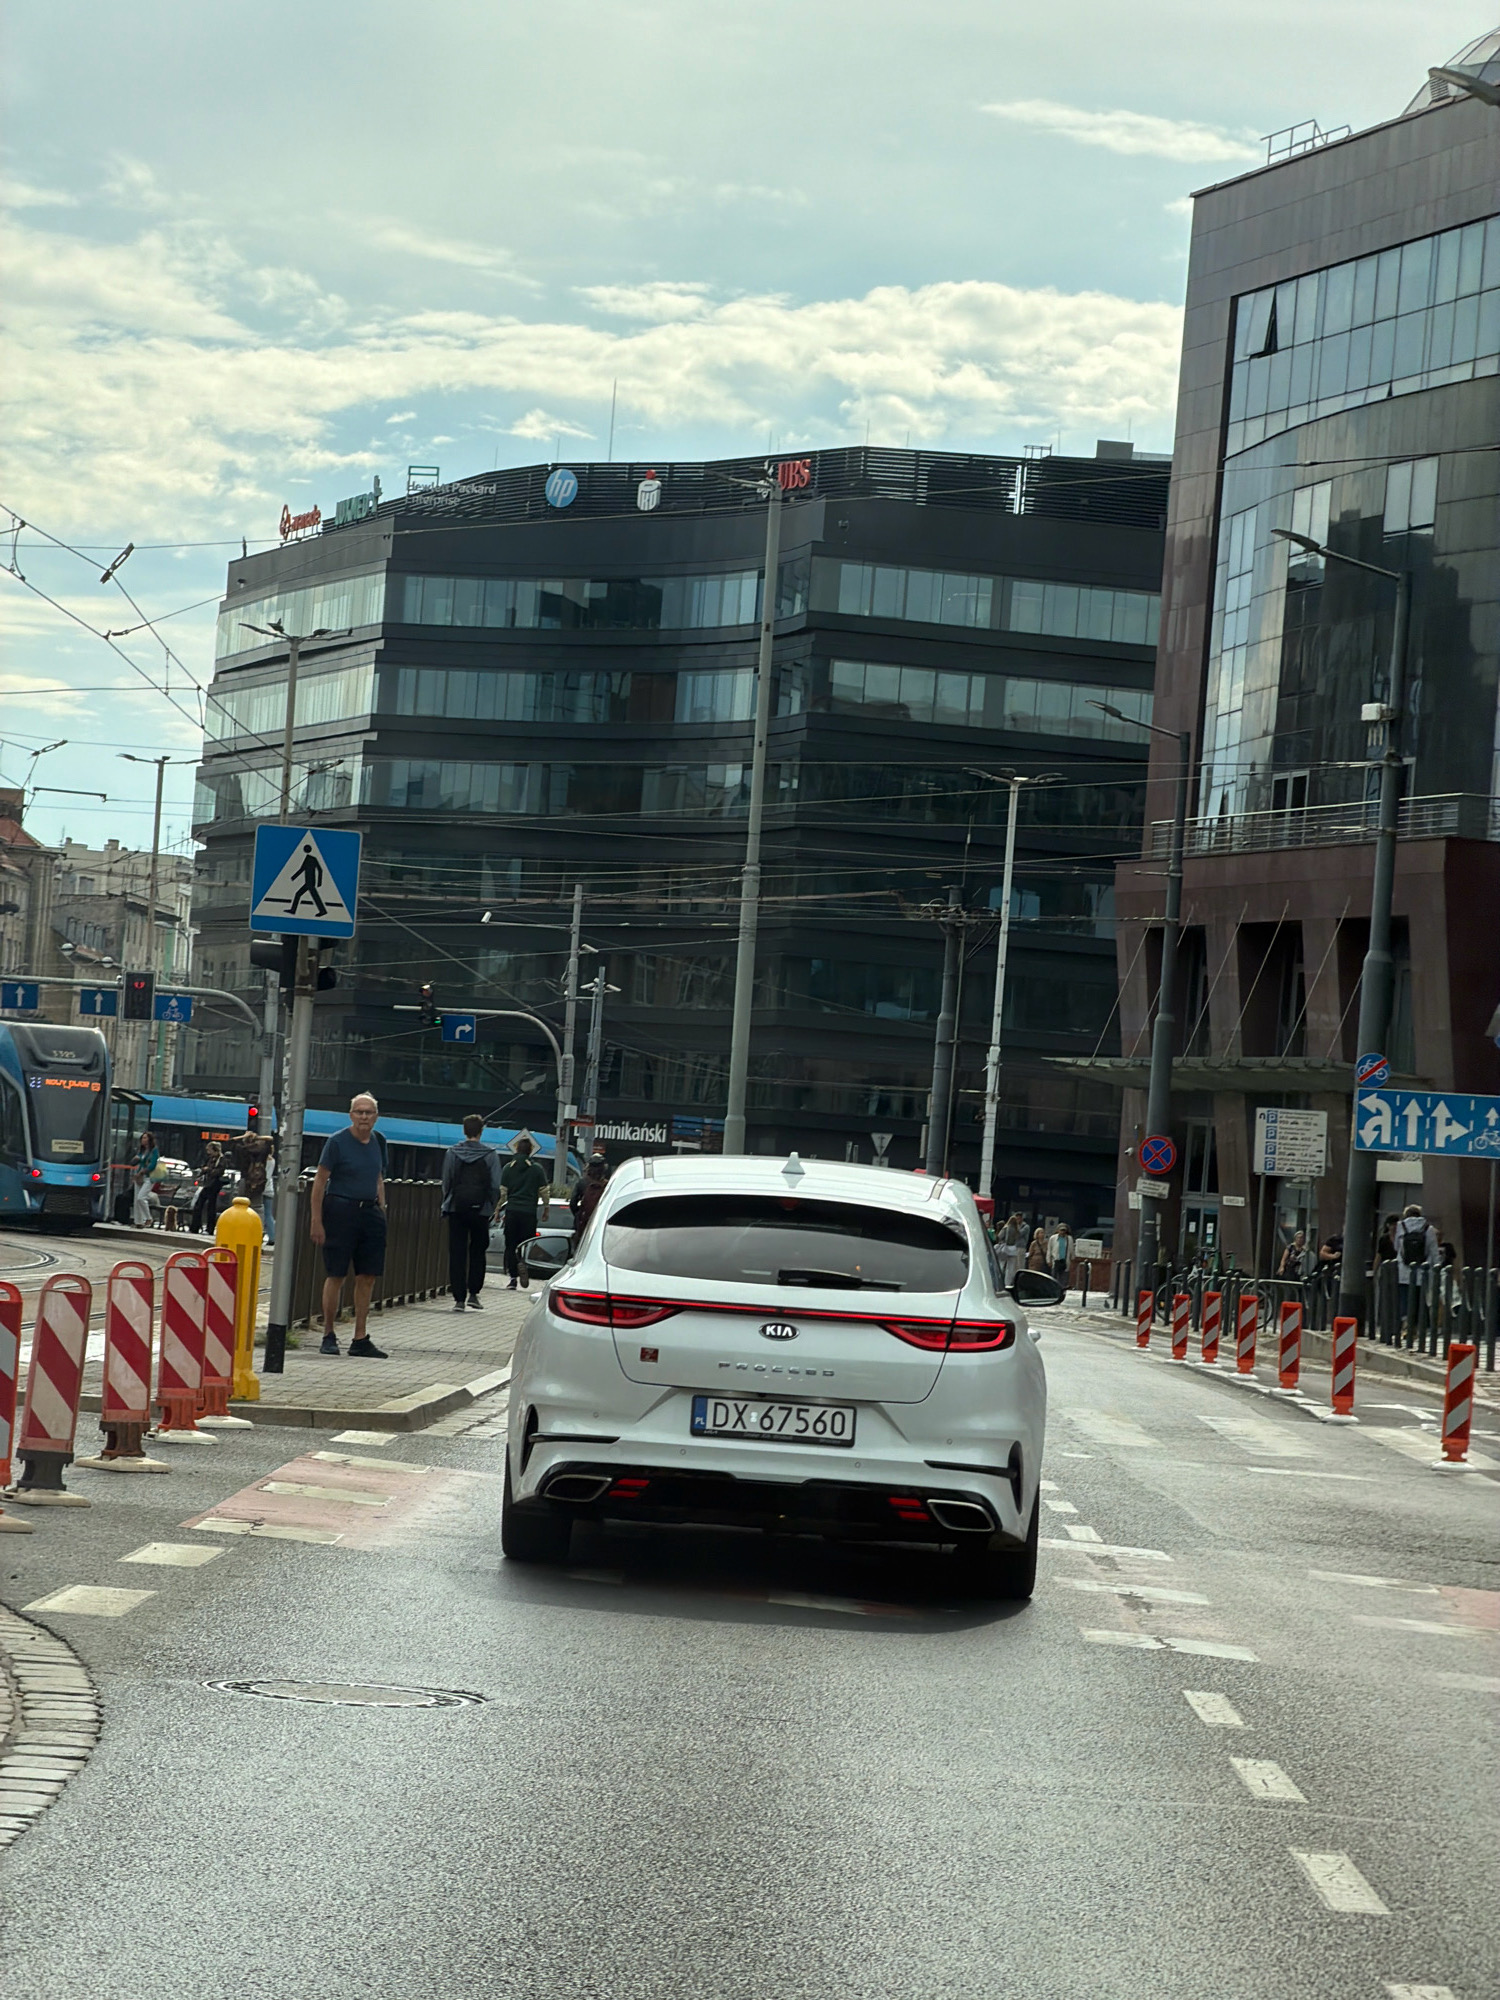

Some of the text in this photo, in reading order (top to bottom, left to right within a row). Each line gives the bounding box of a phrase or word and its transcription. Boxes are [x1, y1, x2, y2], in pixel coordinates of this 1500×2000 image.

[777, 459, 811, 490] UBS
[451, 483, 497, 494] Packard
[548, 469, 576, 507] hp
[573, 1120, 668, 1143] minikański
[765, 1324, 793, 1337] KIA
[718, 1360, 836, 1377] PROCEED
[695, 1417, 705, 1425] PL
[712, 1401, 846, 1437] DX 67560
